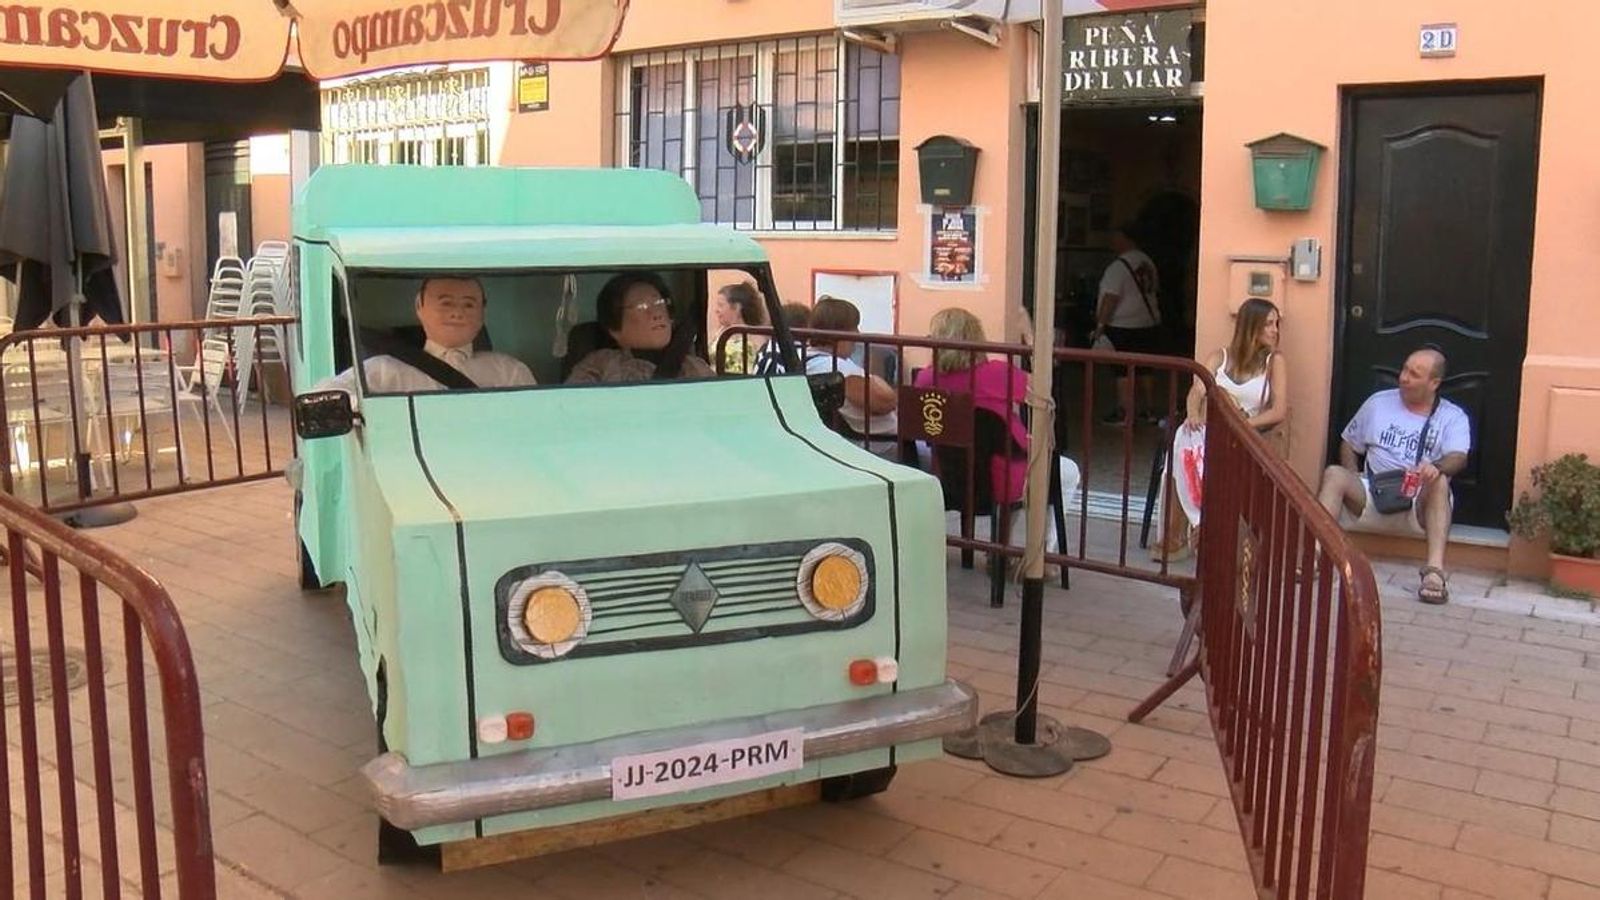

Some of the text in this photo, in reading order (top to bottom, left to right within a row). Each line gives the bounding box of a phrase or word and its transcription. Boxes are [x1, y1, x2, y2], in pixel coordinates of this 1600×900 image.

[1085, 19, 1156, 46] PEÑA
[1069, 45, 1181, 69] RIBERA
[1064, 67, 1184, 92] DEL MAR
